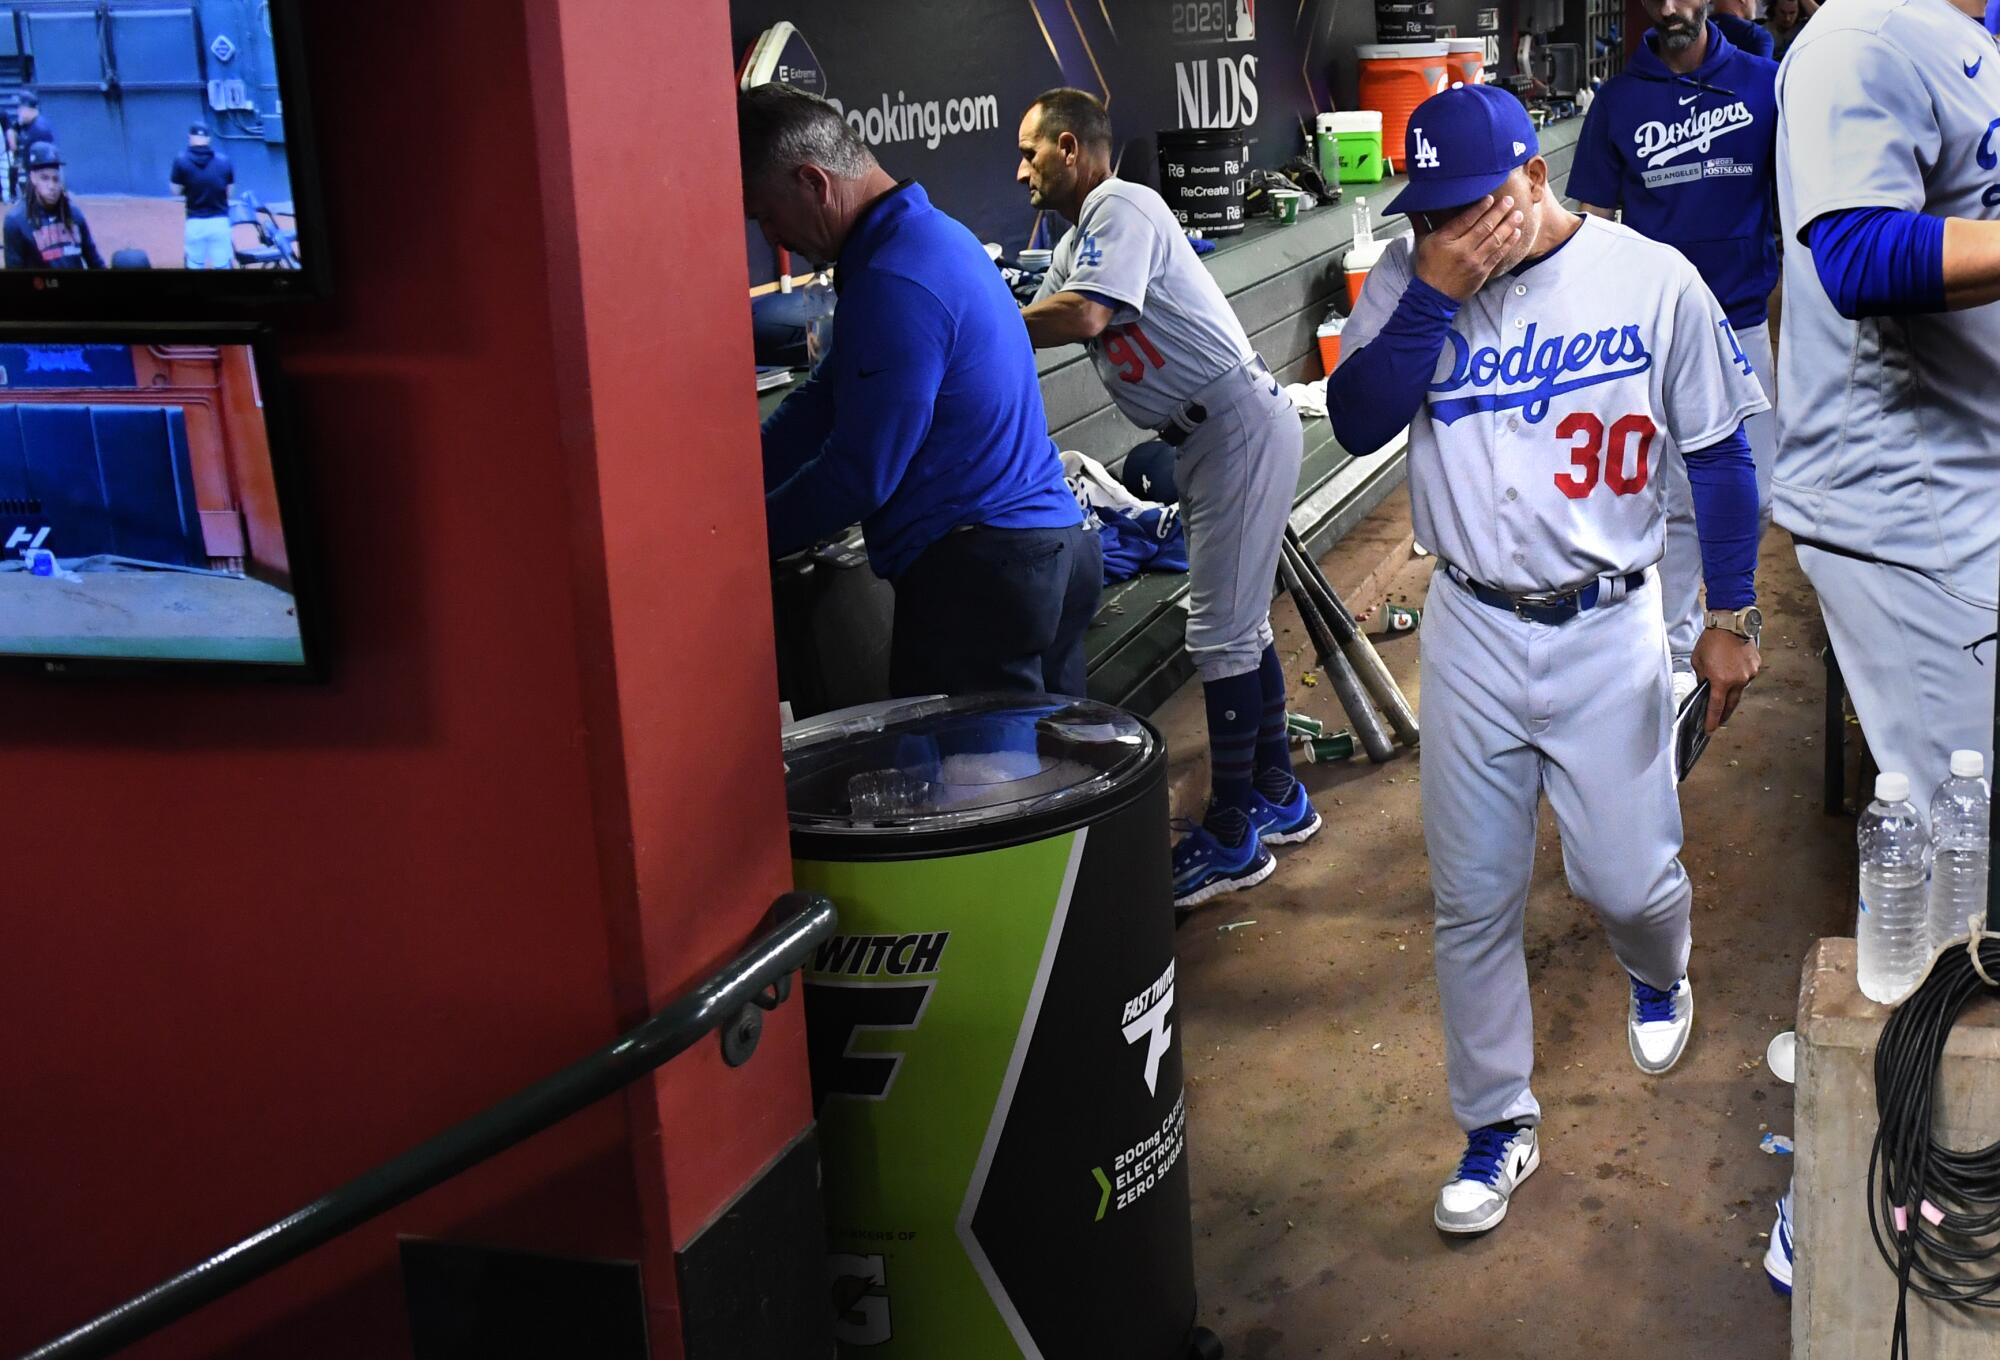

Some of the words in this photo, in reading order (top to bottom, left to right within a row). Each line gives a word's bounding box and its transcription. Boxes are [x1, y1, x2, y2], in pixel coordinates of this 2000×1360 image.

[1172, 2, 1223, 33] 2023
[1174, 53, 1258, 130] NLDS
[827, 90, 999, 150] ooking.com
[1413, 127, 1440, 168] LA
[1647, 174, 1662, 183] LOS
[1664, 168, 1699, 180] ANGELES
[1703, 165, 1753, 176] POSTSEASON
[1180, 186, 1229, 197] ReCreate
[1102, 322, 1166, 384] 91
[1554, 412, 1656, 500] 30
[802, 931, 951, 975] WITCH
[1121, 986, 1152, 1026] FAST
[1114, 1130, 1160, 1171] 200mg
[1117, 1173, 1155, 1211] ZERO
